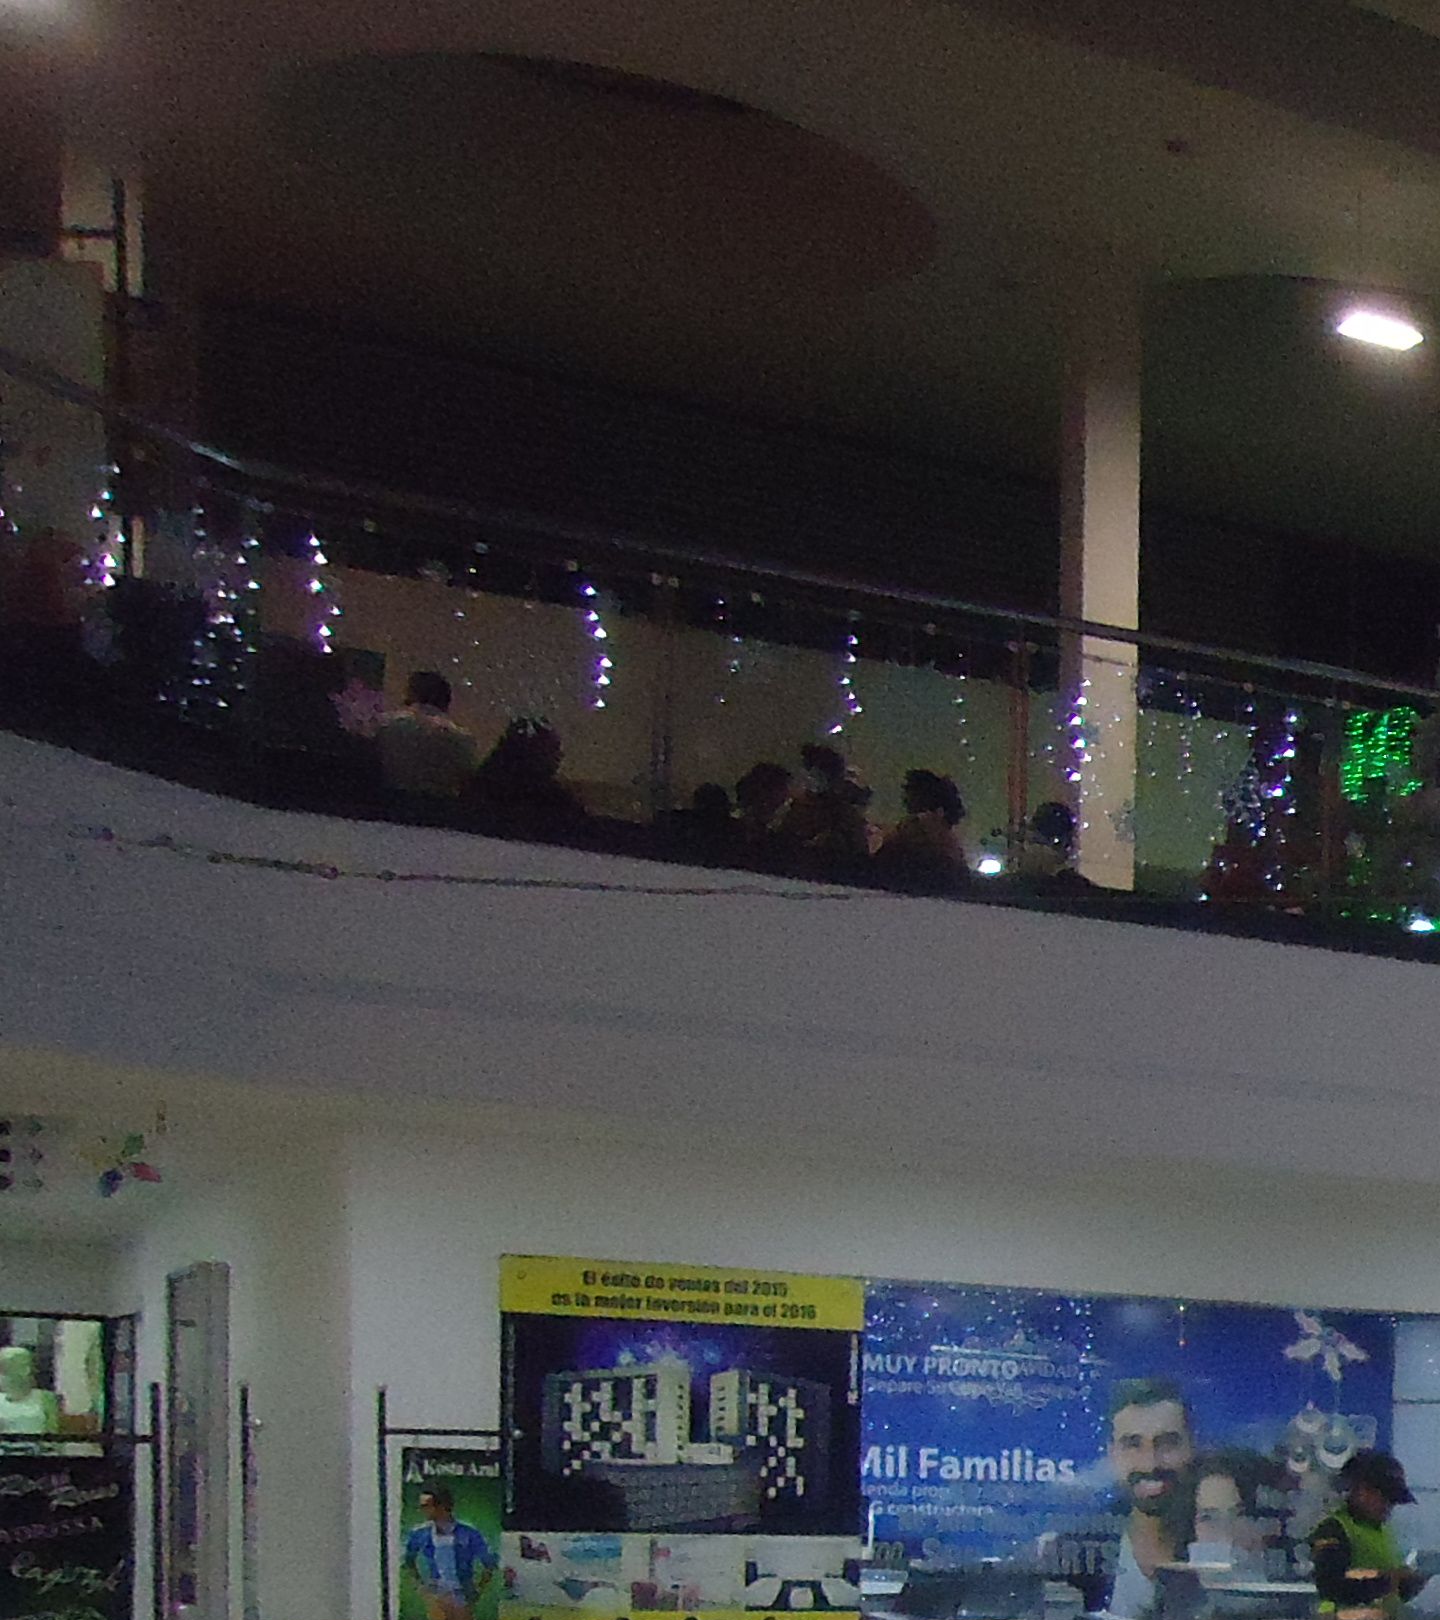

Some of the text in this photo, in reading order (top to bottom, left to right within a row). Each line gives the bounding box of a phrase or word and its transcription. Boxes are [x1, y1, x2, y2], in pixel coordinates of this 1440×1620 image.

[863, 1353, 1019, 1380] MUY PRONTO
[919, 1448, 1075, 1482] Familias
